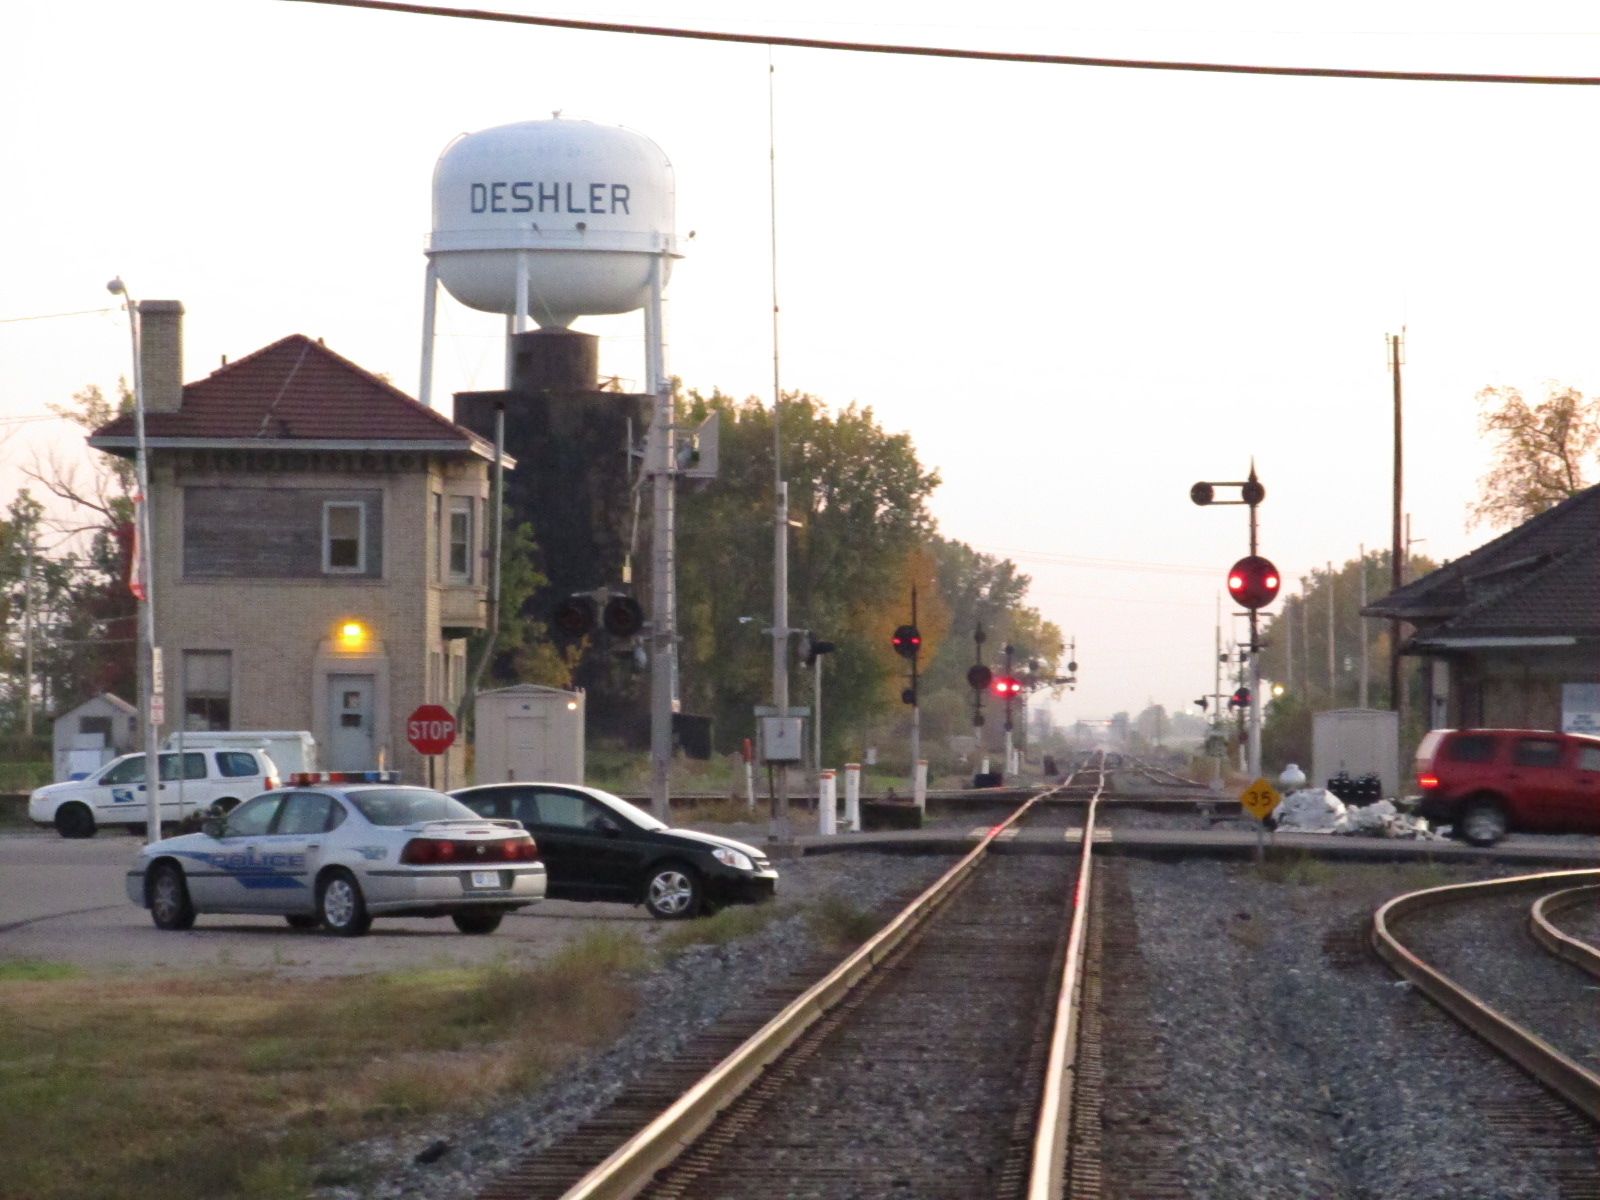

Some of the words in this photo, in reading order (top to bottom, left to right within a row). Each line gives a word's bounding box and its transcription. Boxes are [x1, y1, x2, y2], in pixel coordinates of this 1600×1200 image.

[471, 182, 630, 215] DESHLER
[409, 720, 454, 740] STOP
[1248, 791, 1272, 806] 35
[209, 853, 306, 868] POLICE
